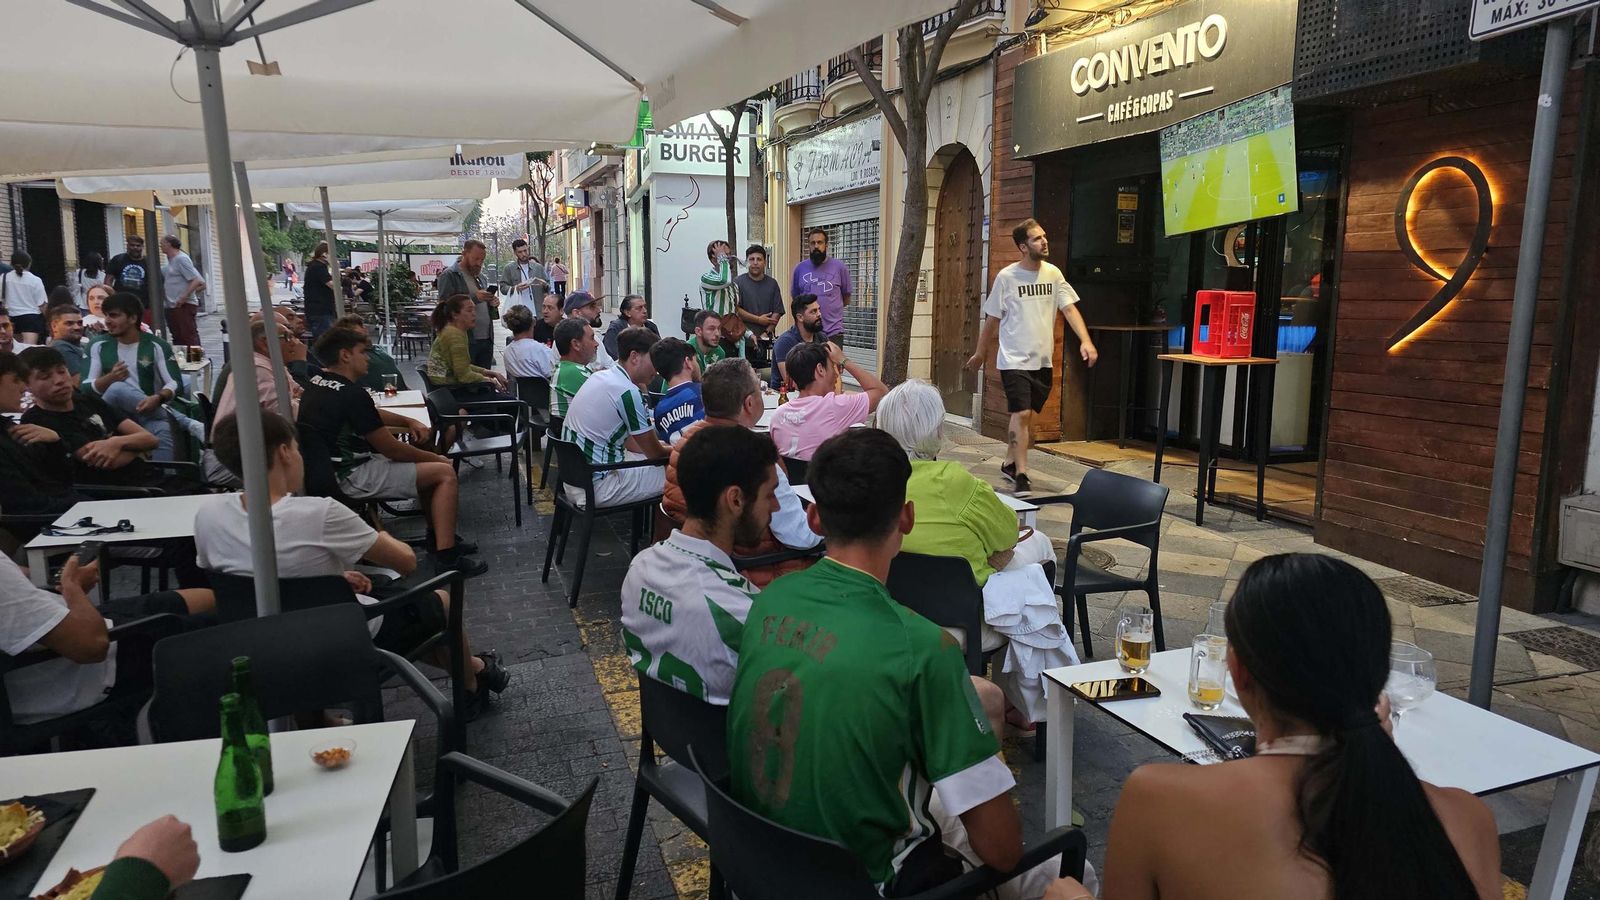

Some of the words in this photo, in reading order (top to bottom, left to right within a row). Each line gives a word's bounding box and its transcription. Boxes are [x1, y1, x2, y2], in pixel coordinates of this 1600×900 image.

[1491, 1, 1528, 24] MÁX:
[1071, 14, 1227, 94] CONVENTO
[1108, 90, 1173, 124] CAFÉ&COPAS
[660, 143, 742, 164] BURGER
[1386, 156, 1493, 351] 9
[1018, 283, 1052, 297] PUMA
[660, 402, 694, 433] JOAQUÍN
[639, 587, 672, 625] ISCO
